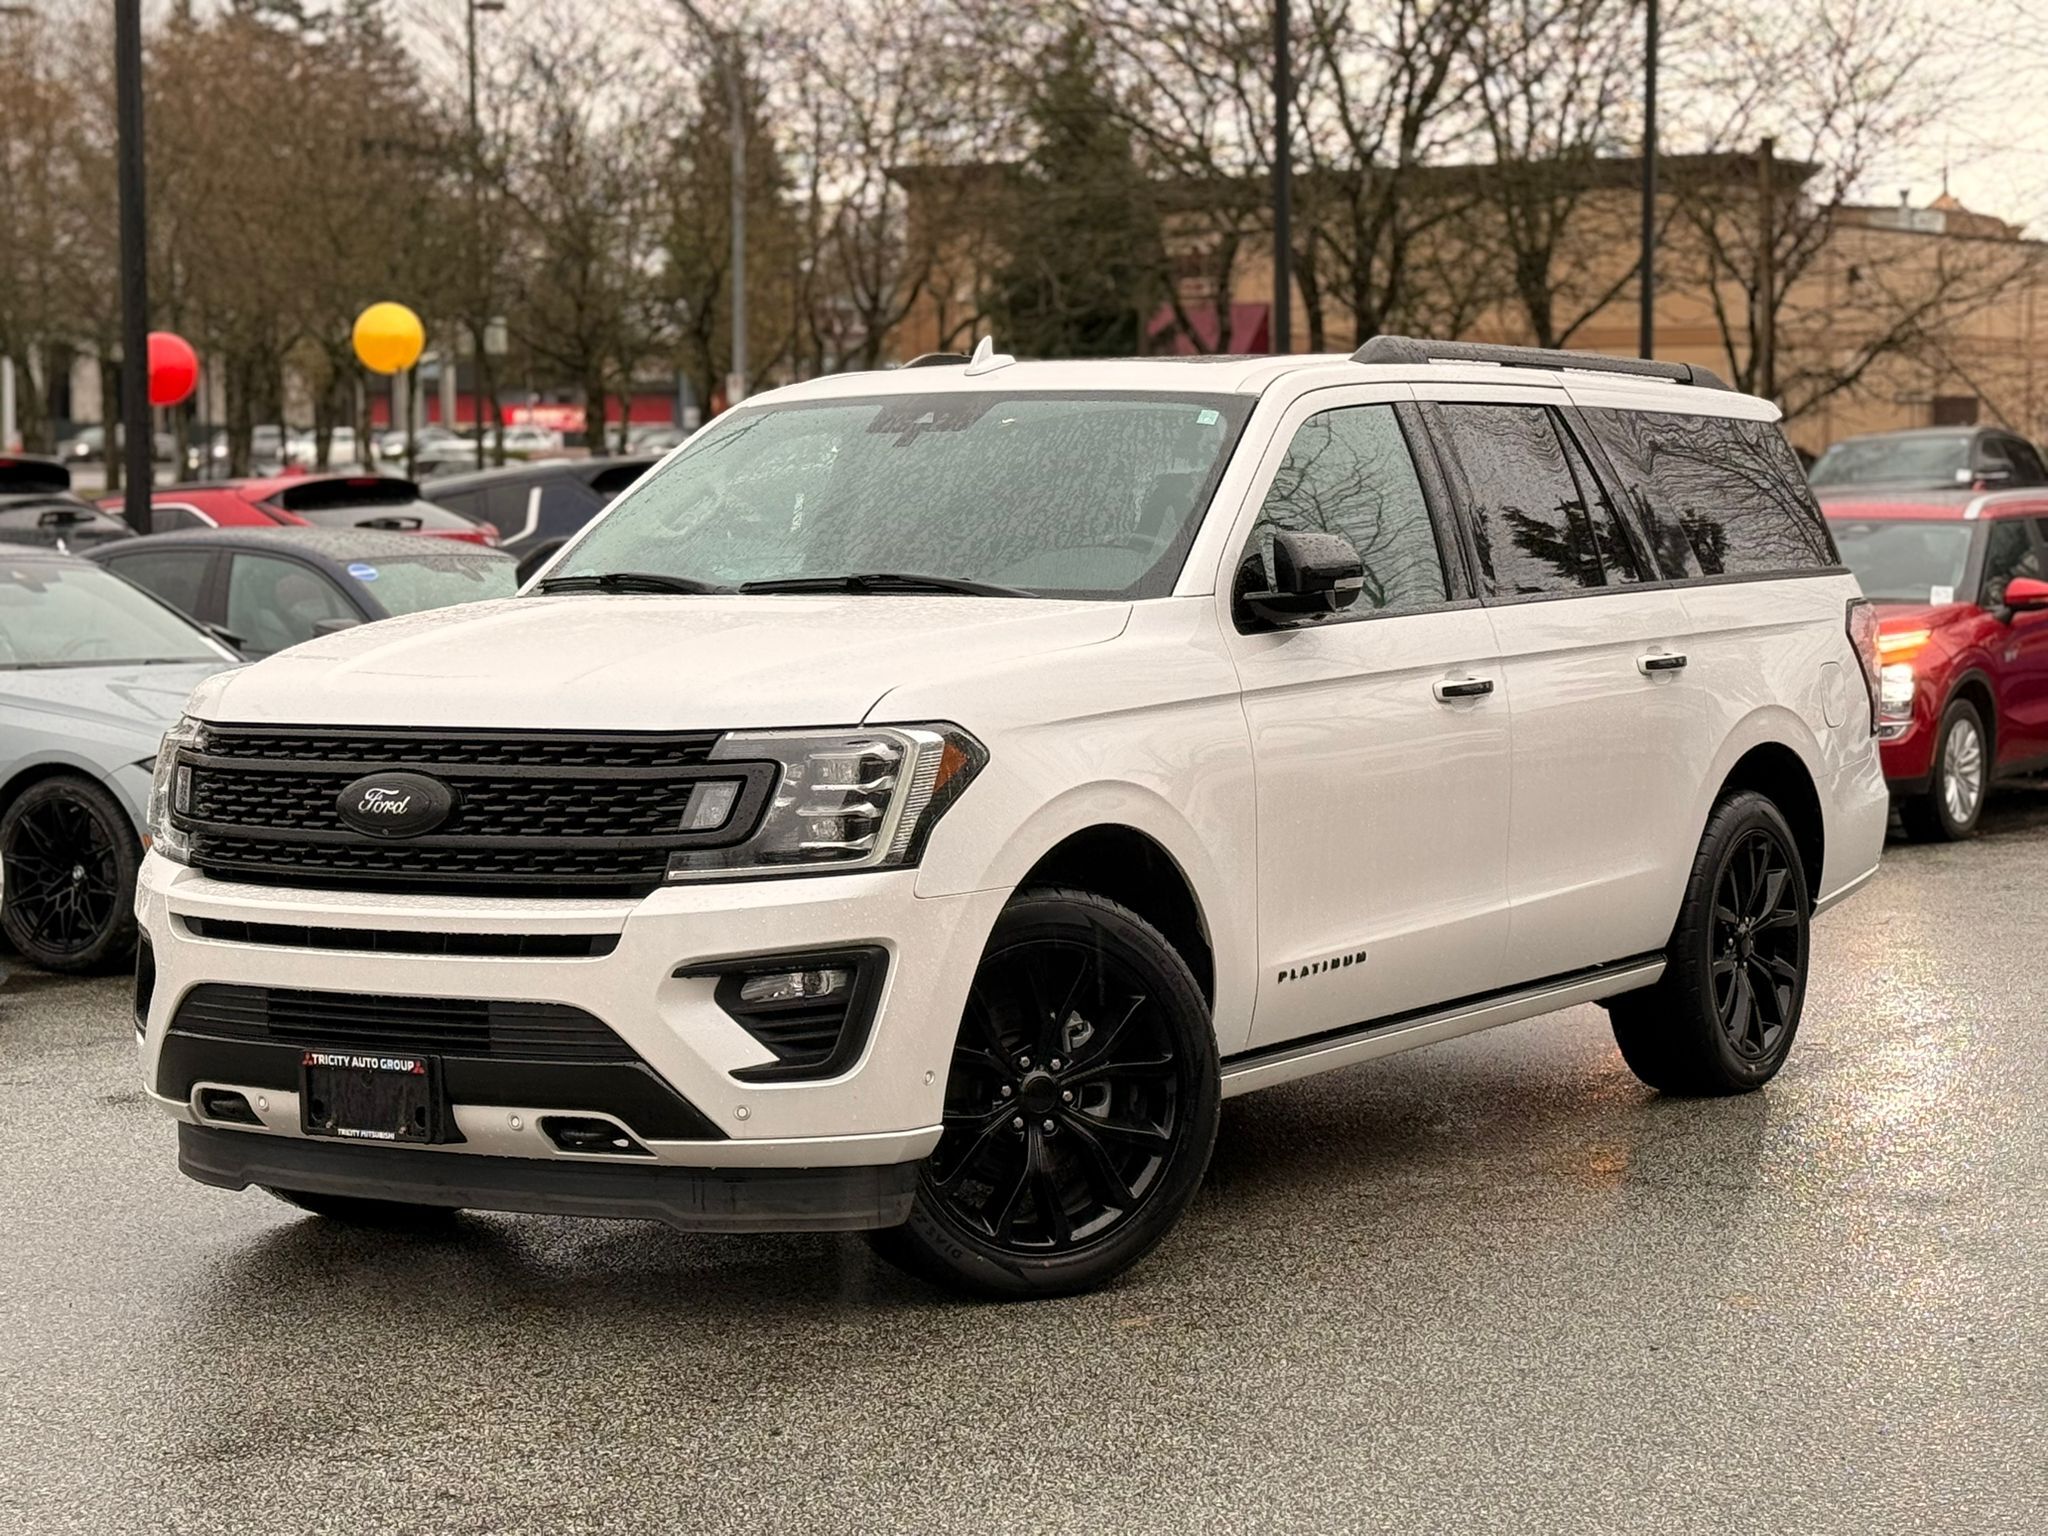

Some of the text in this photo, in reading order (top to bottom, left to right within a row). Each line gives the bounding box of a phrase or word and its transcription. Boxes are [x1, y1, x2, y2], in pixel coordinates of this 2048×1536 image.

[358, 787, 411, 814] Ford
[1278, 951, 1367, 984] PLATINUM
[312, 1053, 414, 1072] TRICITY AUTO GROUP
